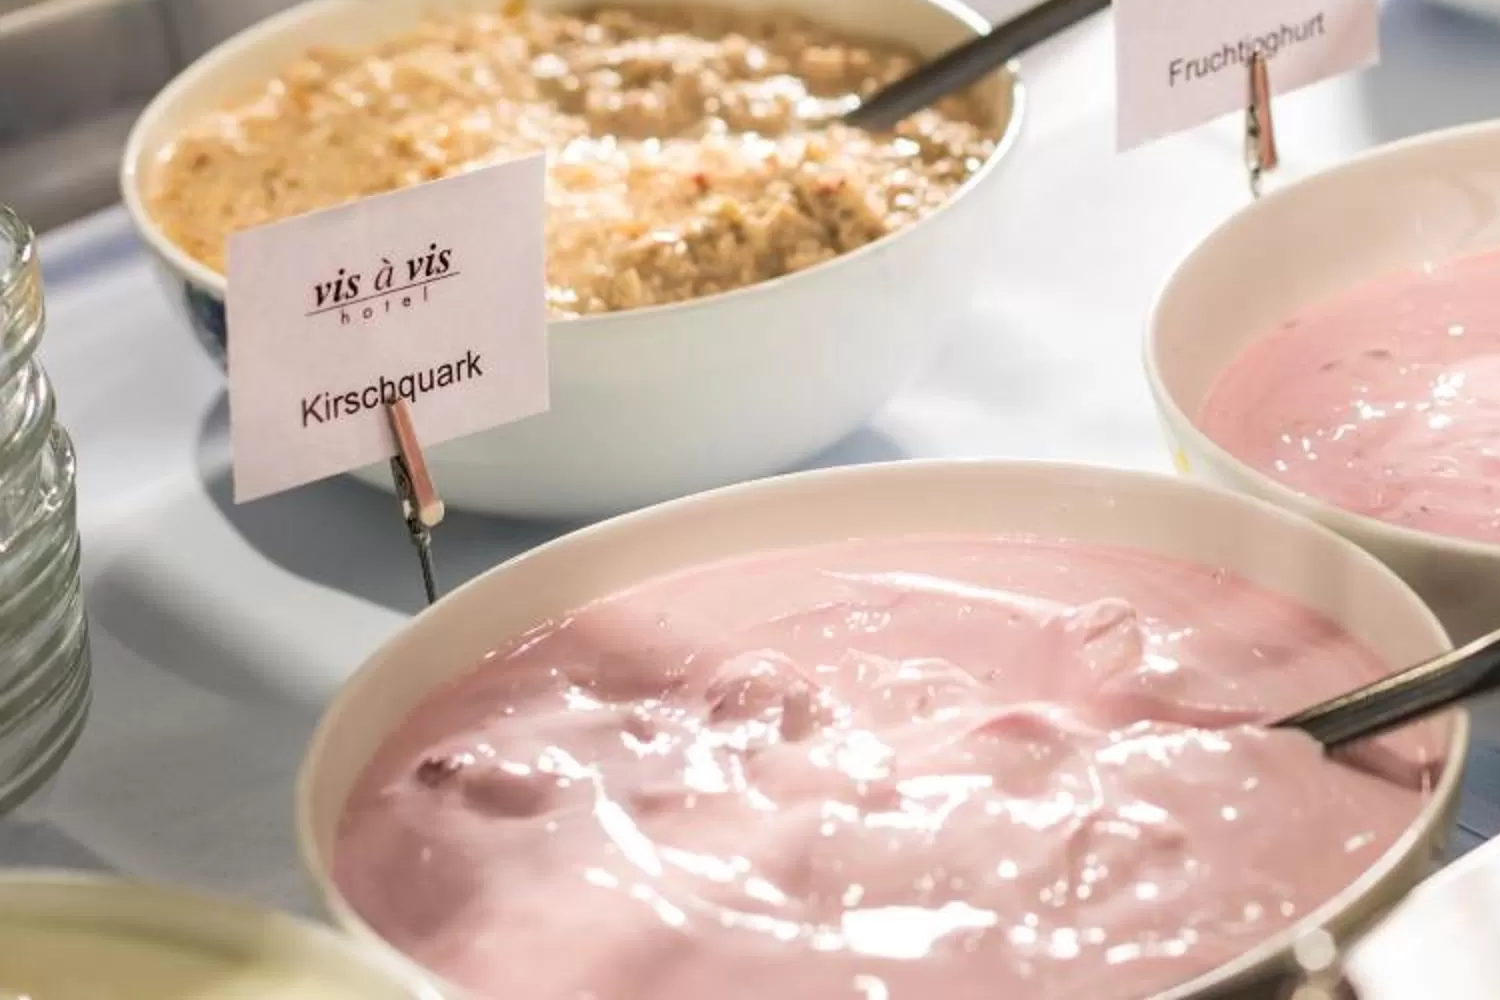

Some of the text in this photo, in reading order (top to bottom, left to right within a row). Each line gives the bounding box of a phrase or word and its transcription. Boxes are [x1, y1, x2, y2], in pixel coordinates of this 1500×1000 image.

[314, 243, 453, 307] vis à vis
[340, 286, 429, 325] hotel
[301, 350, 483, 428] Kirschquark
